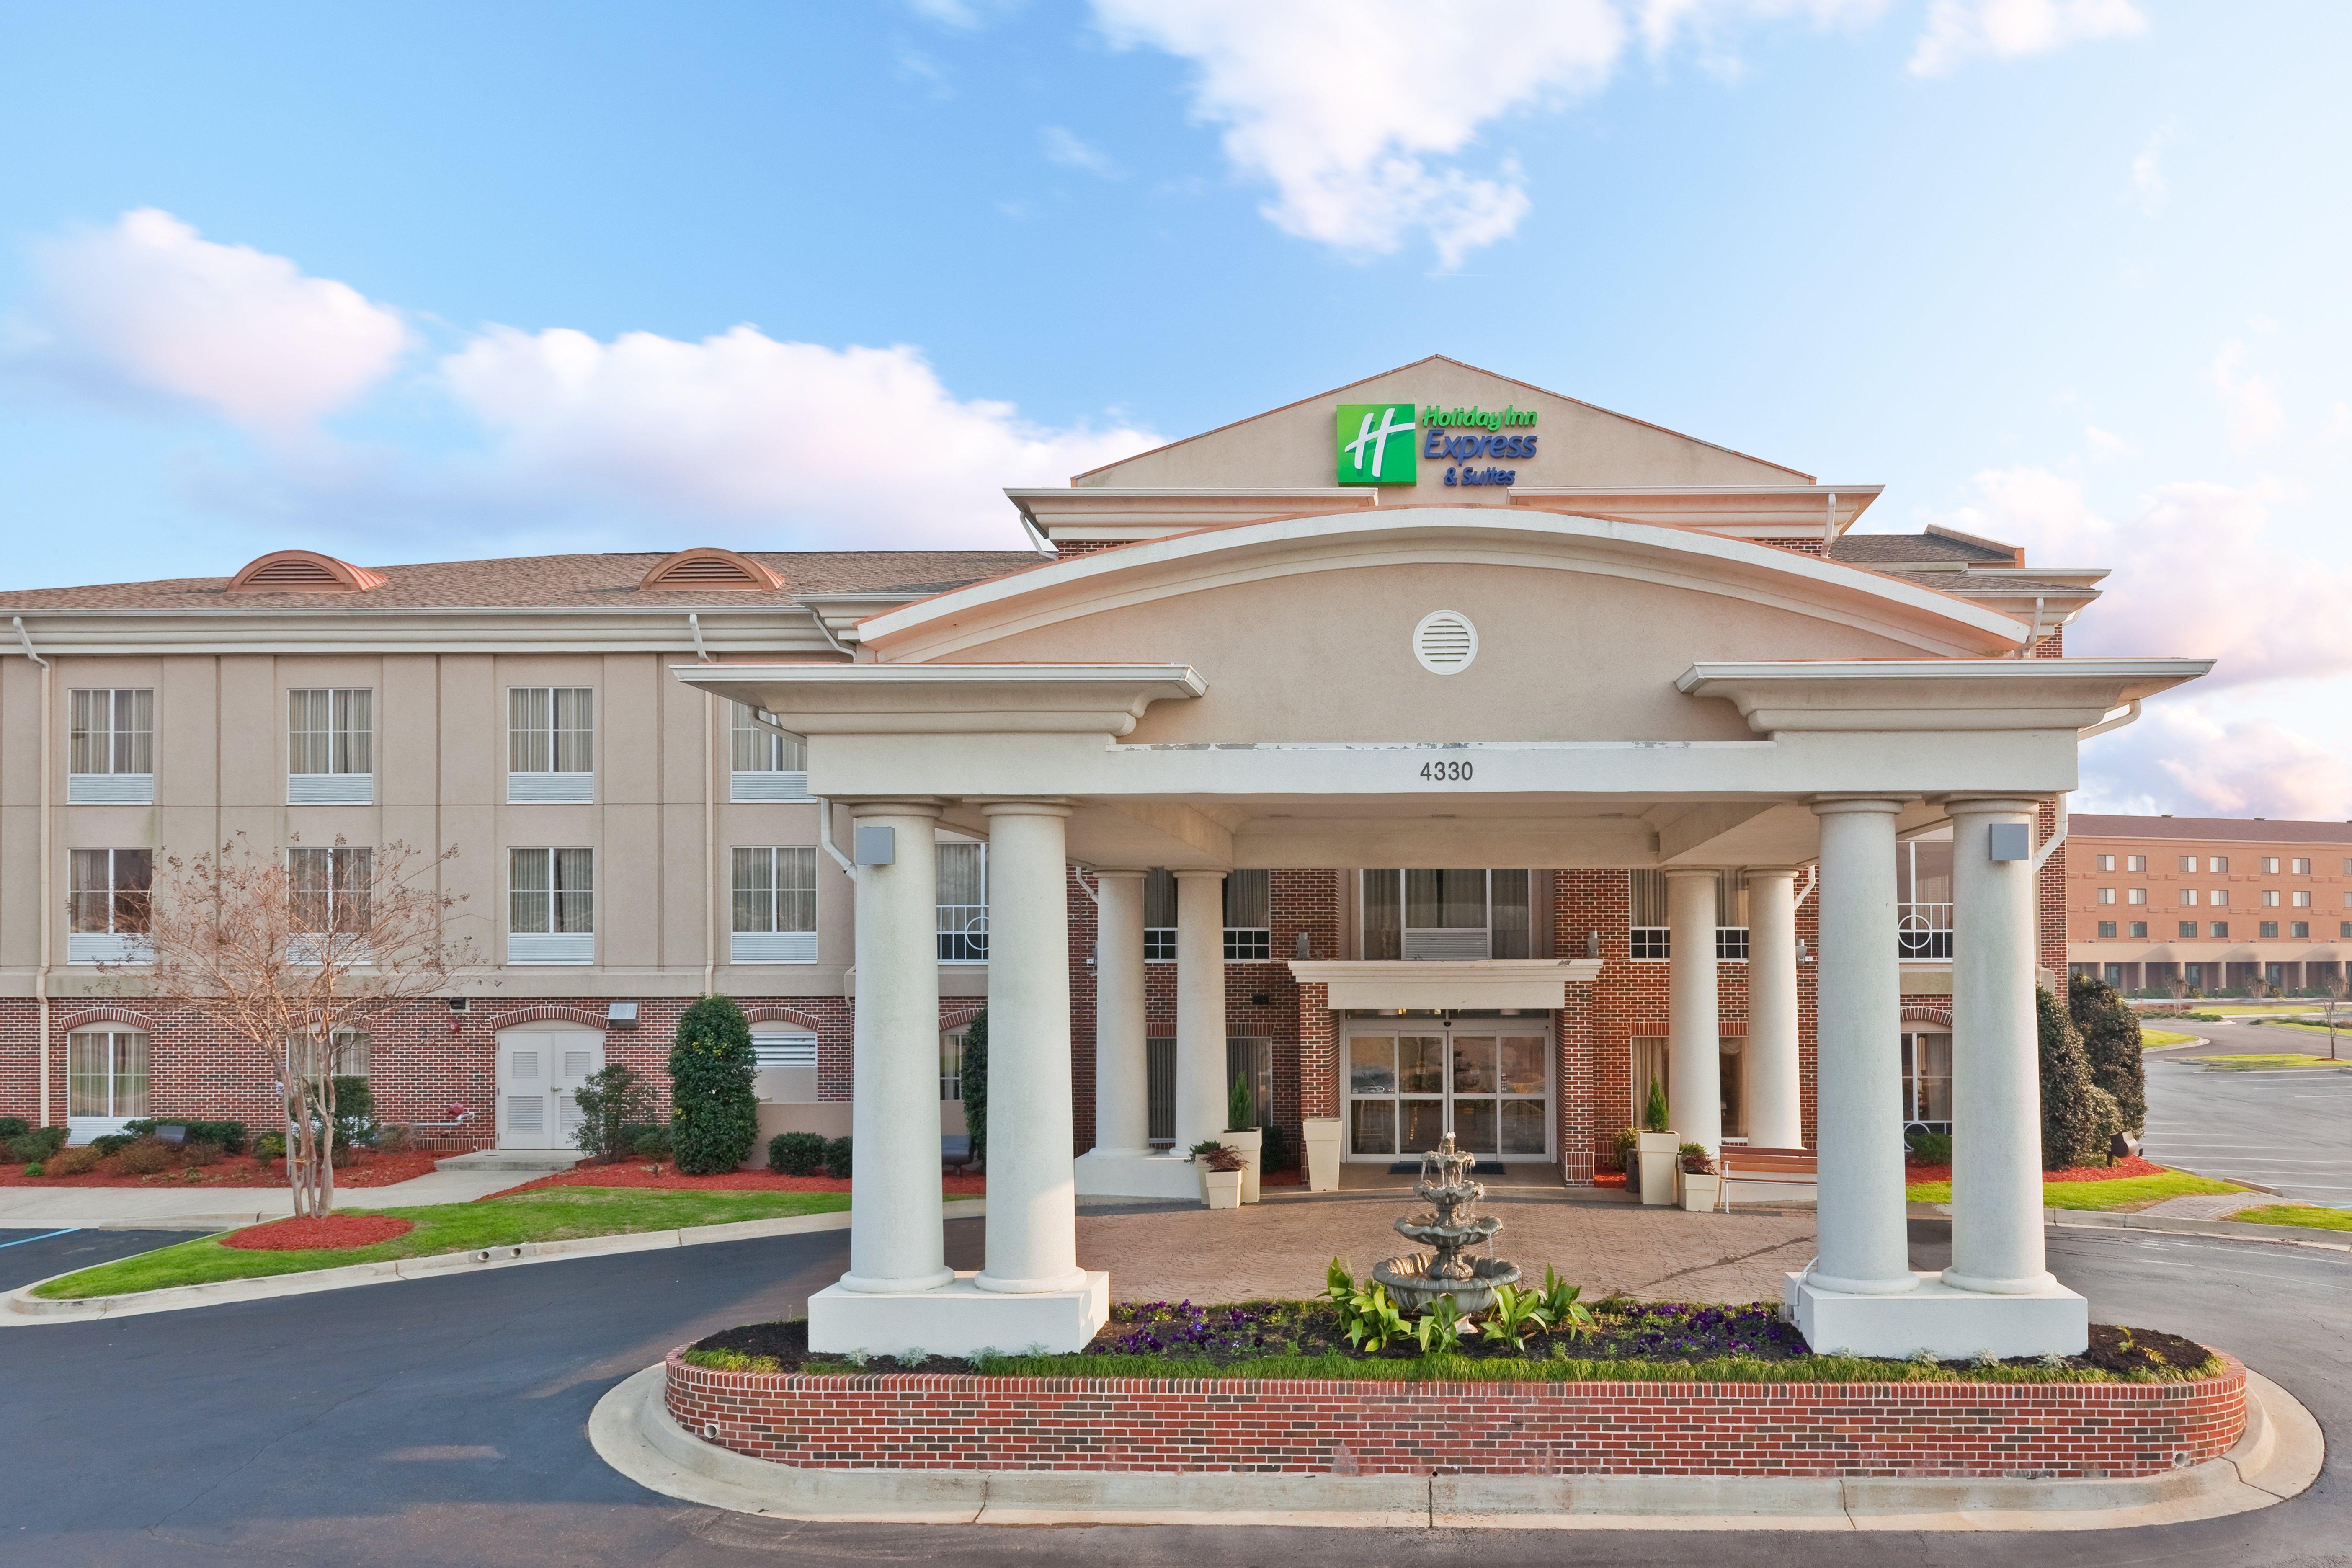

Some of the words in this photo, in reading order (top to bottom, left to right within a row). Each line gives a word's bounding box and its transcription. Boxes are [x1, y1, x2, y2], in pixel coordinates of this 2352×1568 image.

[1422, 405, 1503, 431] Holiday
[1505, 405, 1537, 427] Inn
[1424, 429, 1537, 466] Express
[1444, 467, 1457, 486] &
[1461, 467, 1516, 486] Suites
[1420, 761, 1473, 781] 4330
